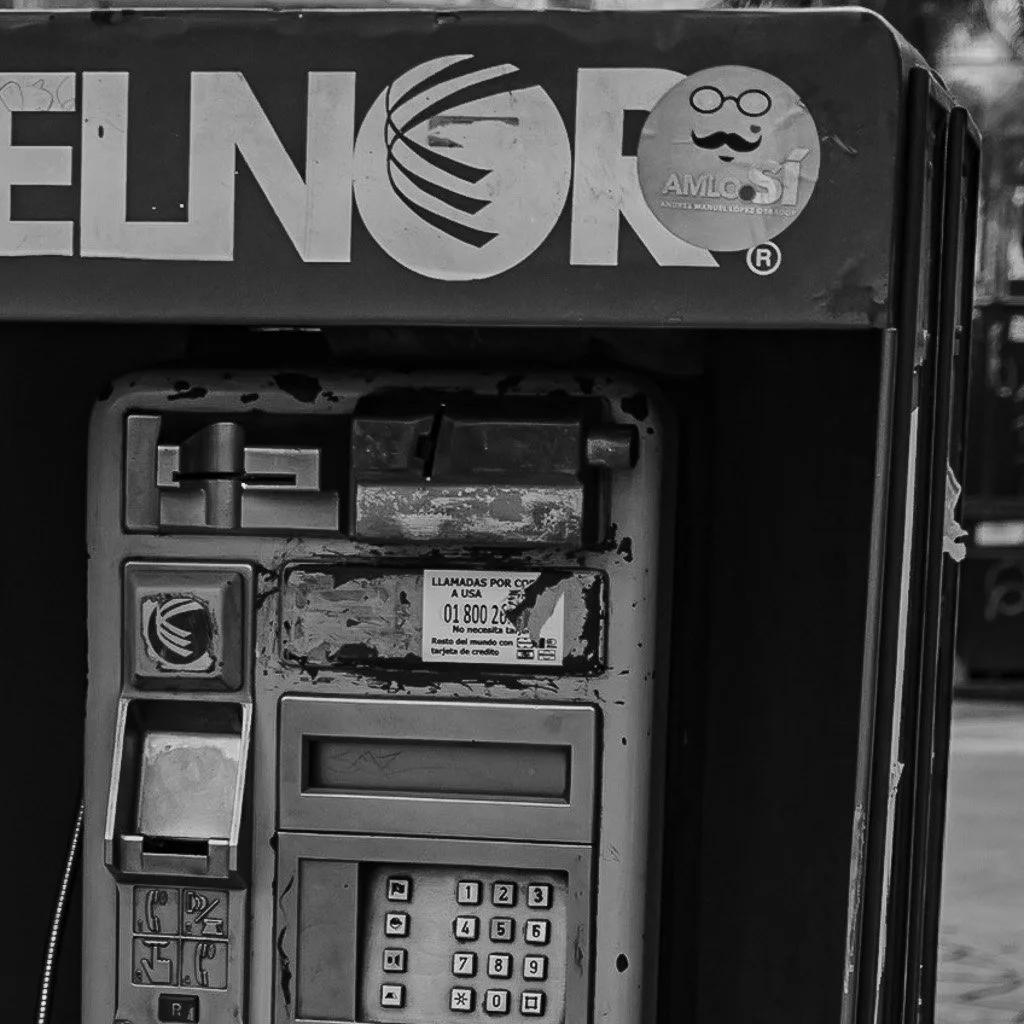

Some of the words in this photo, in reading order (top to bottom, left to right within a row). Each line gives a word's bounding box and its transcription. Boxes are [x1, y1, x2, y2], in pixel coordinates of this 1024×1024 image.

[432, 577, 487, 587] LLAMADAS
[490, 578, 512, 588] POR
[514, 578, 536, 588] CO
[451, 589, 458, 598] A
[461, 589, 482, 598] USA
[443, 604, 460, 624] 01
[463, 604, 488, 624] 800
[453, 625, 465, 633] No
[467, 626, 503, 635] necesita
[455, 637, 468, 646] del
[498, 639, 514, 647] con
[460, 648, 470, 656] de
